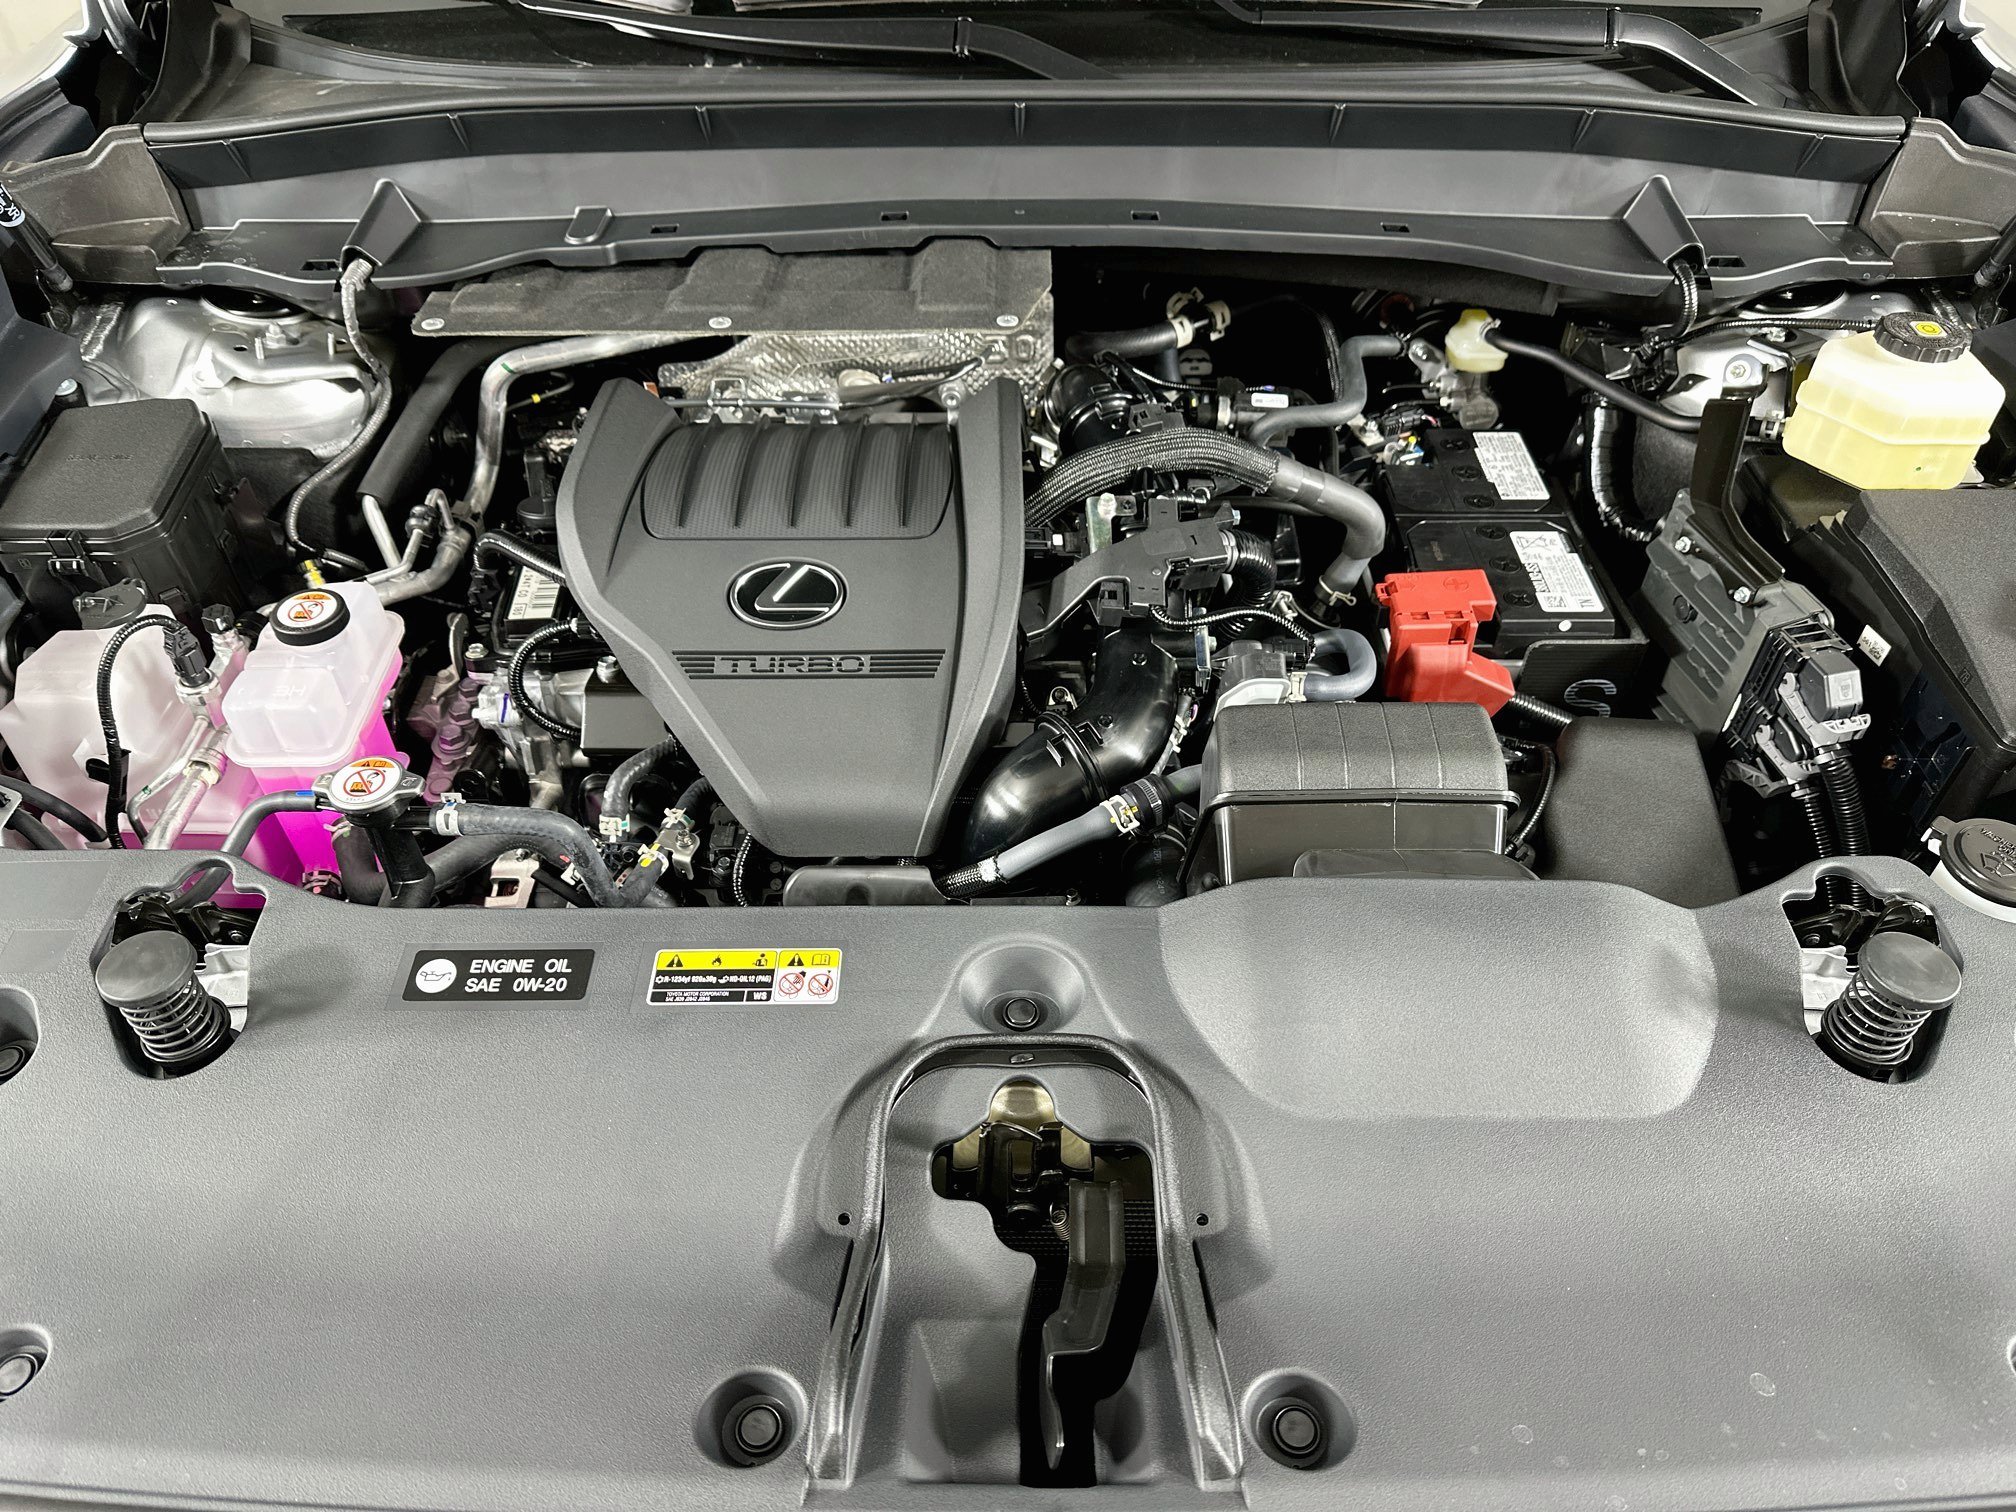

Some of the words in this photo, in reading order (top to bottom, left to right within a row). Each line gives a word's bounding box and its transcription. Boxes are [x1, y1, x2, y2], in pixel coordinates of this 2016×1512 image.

[719, 656, 866, 674] TURBO
[469, 958, 535, 974] ENGINE
[544, 958, 573, 974] OIL
[464, 977, 503, 993] SAE
[512, 977, 568, 993] 0W-20
[755, 974, 771, 984] (PAG)
[753, 991, 768, 1000] WS
